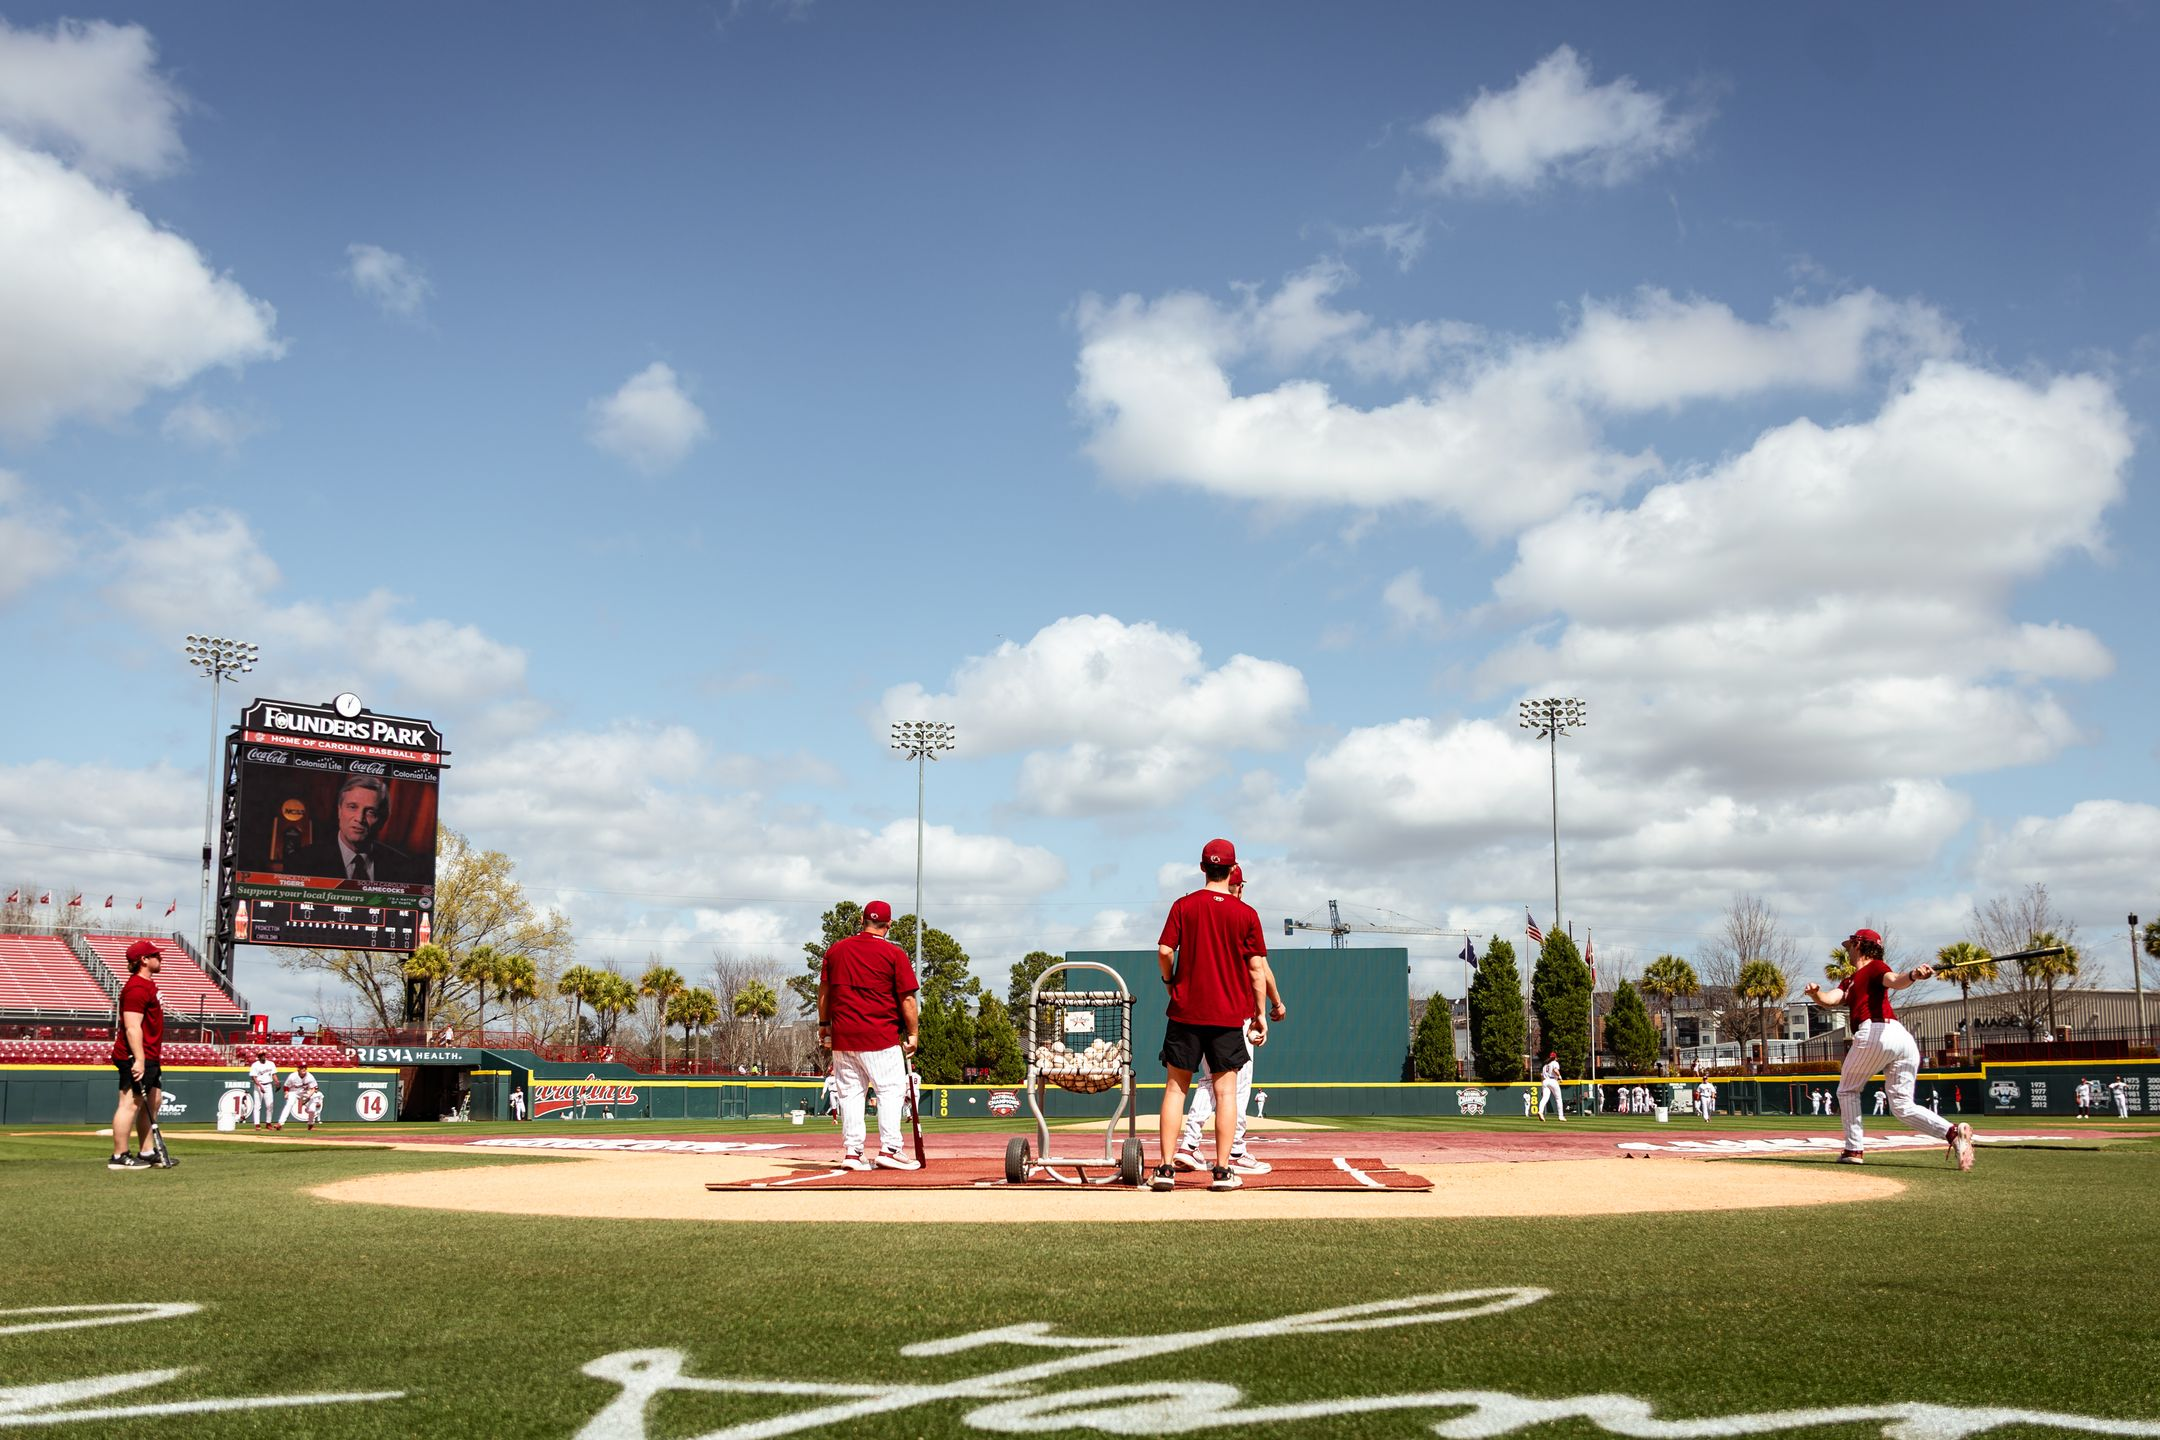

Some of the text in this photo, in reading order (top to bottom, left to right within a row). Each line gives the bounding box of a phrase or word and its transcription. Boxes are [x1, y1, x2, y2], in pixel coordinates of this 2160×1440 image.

[271, 735, 300, 745] HOME
[318, 742, 366, 753] CAROLINA
[369, 747, 416, 759] BASEBALL
[295, 759, 342, 771] Colonial Life
[393, 769, 438, 781] Colonial Life
[279, 879, 305, 887] TIGERS
[237, 886, 364, 902] Support your local farmers
[362, 886, 405, 894] GAMECOCKS
[300, 903, 315, 911] BALL
[333, 905, 353, 913] STRIKE
[304, 910, 311, 920] 0
[339, 912, 346, 922] 0
[371, 914, 378, 924] 0
[345, 1047, 414, 1062] PRISMA
[1990, 1086, 2019, 1097] CWS
[363, 1096, 382, 1114] 14
[940, 1089, 949, 1116] 380
[1530, 1087, 1538, 1114] 380
